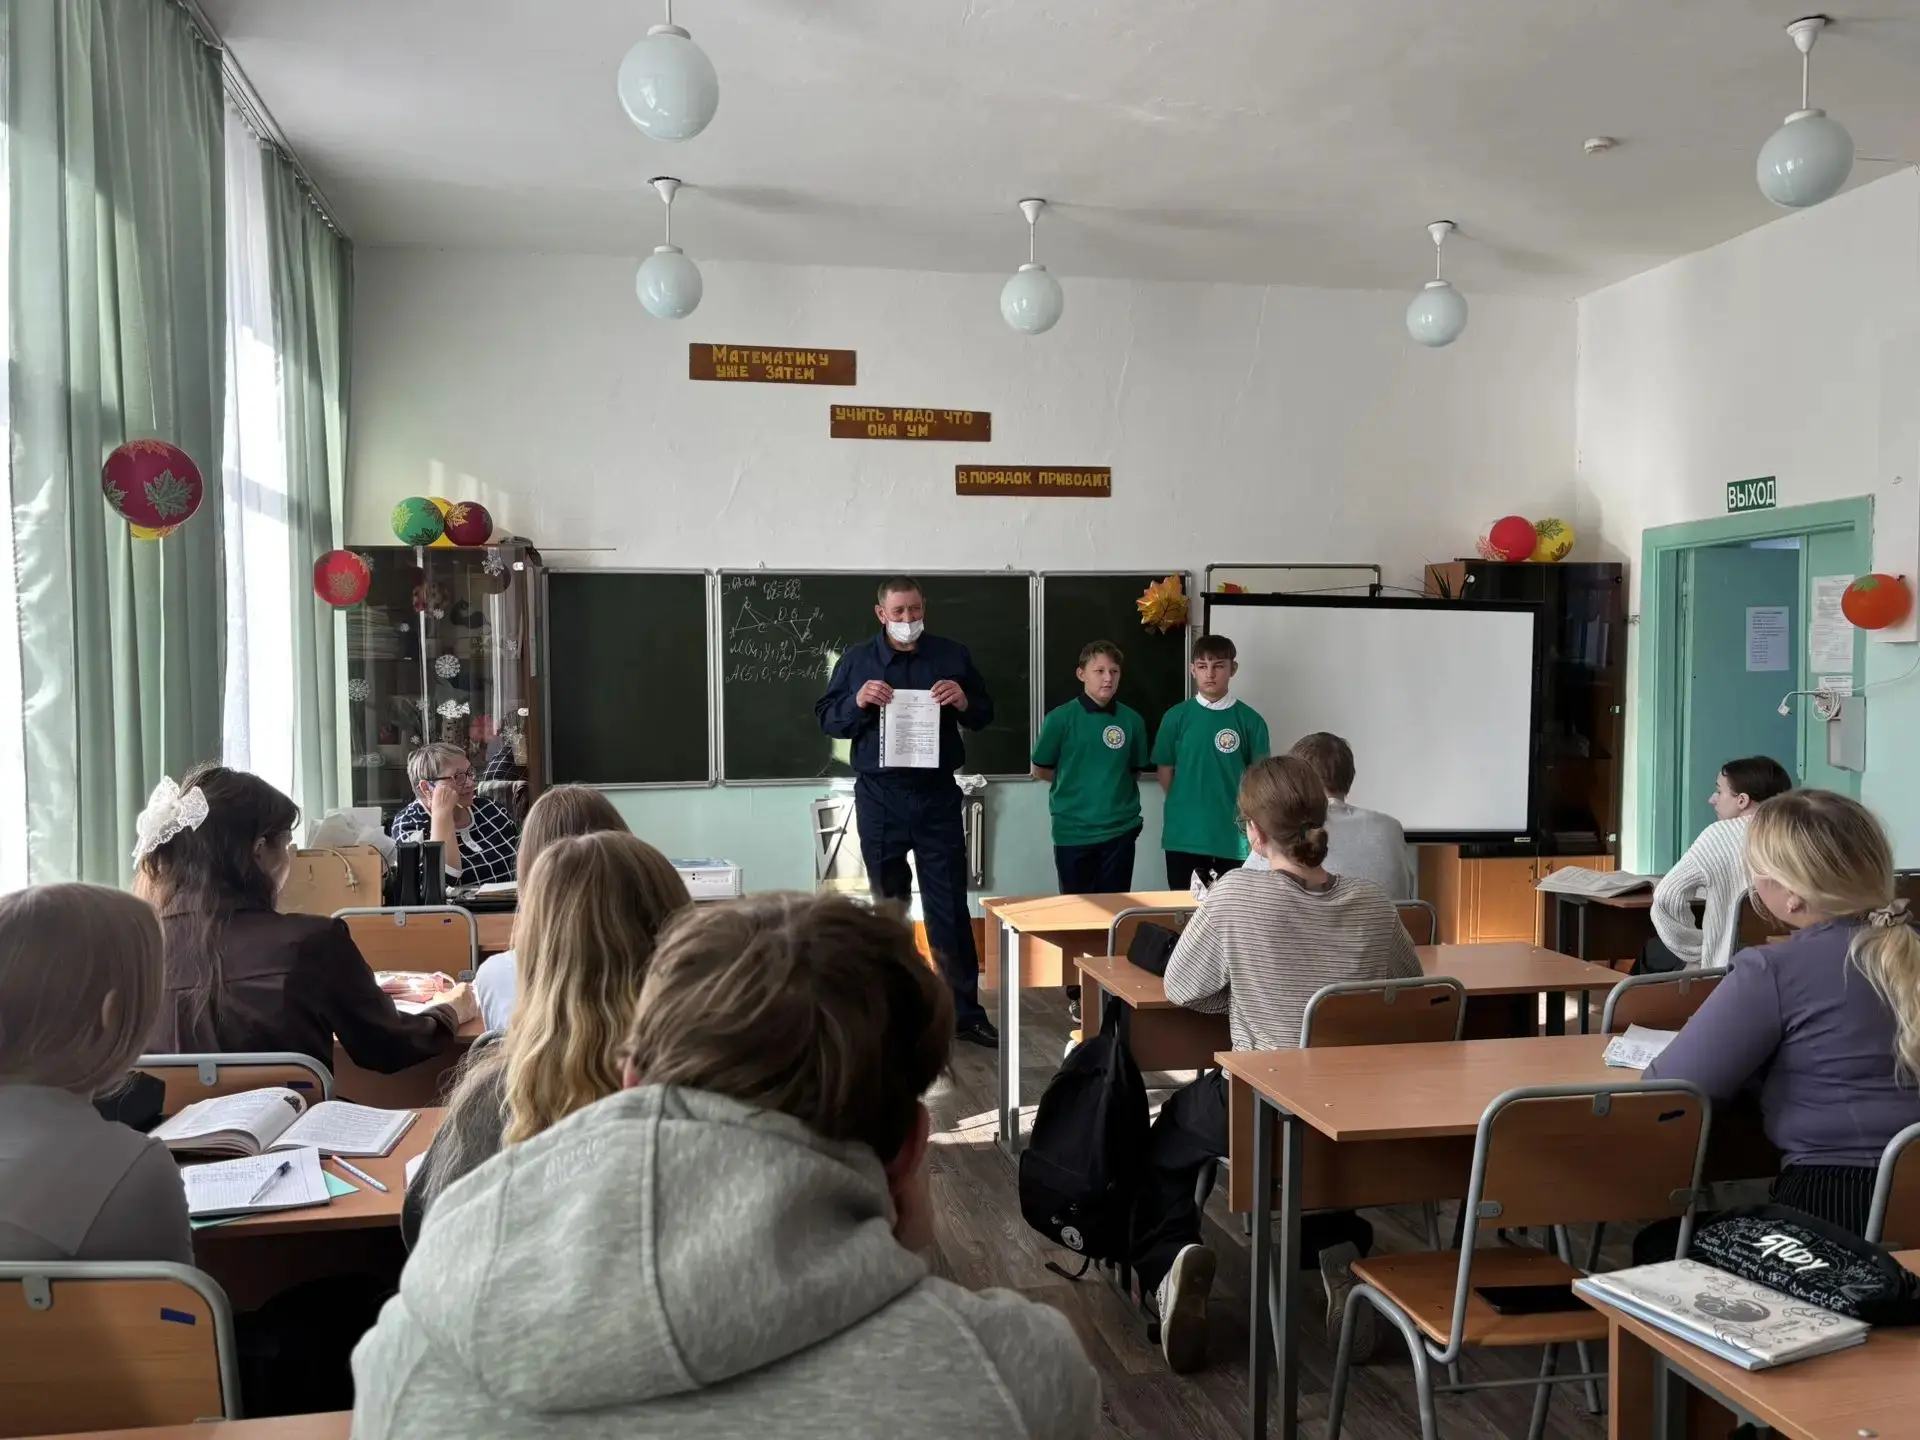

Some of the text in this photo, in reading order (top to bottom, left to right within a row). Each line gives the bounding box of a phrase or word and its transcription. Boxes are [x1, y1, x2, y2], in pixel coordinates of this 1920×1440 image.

[716, 365, 815, 380] УЖЕ ЗАТЕМ
[835, 407, 885, 422] УЧИТЬ
[943, 412, 973, 425] ЧТО
[867, 423, 929, 437] ОНА УМ
[958, 471, 1110, 487] В ПОРЯДОК ПРИВОДИТ
[1728, 480, 1775, 508] ВЫХОД
[1751, 1233, 1829, 1273] STUDY
